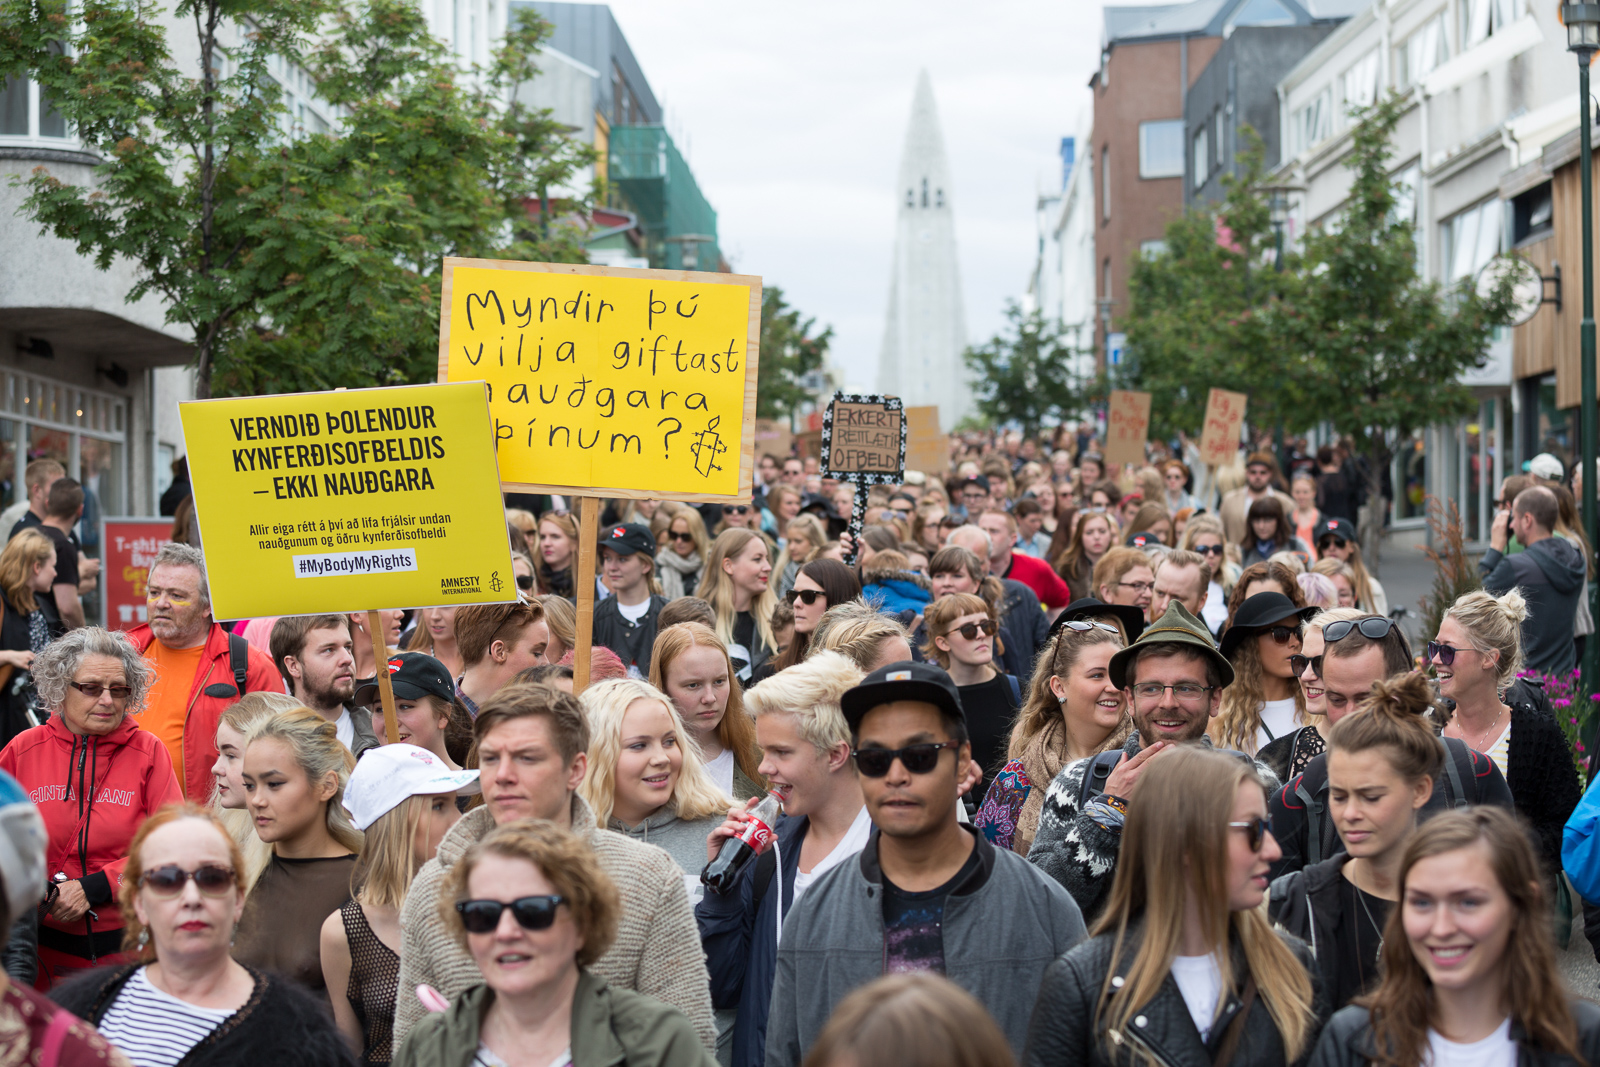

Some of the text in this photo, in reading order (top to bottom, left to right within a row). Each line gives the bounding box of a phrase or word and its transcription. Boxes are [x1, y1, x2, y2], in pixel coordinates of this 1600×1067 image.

[466, 288, 700, 331] Myndir þú
[463, 333, 739, 376] vilja giftast
[229, 405, 437, 441] VERNDIÐ ÞOLENDUR
[836, 407, 900, 428] EKKERT
[231, 435, 446, 472] KYNFERÐISOFBELDIS
[272, 474, 319, 500] EKKI
[323, 467, 435, 496] NAUÐGARA
[249, 512, 451, 537] Allir eiga rétt á því að lifa frjálsir undan
[258, 526, 447, 550] nauðgunum og öðru kynferðisofbeldi
[299, 554, 412, 575] #MyBodyMyRights
[441, 576, 480, 588] AMNESTY
[442, 587, 482, 595] INTERNATIONAL
[29, 785, 76, 806] CINTA
